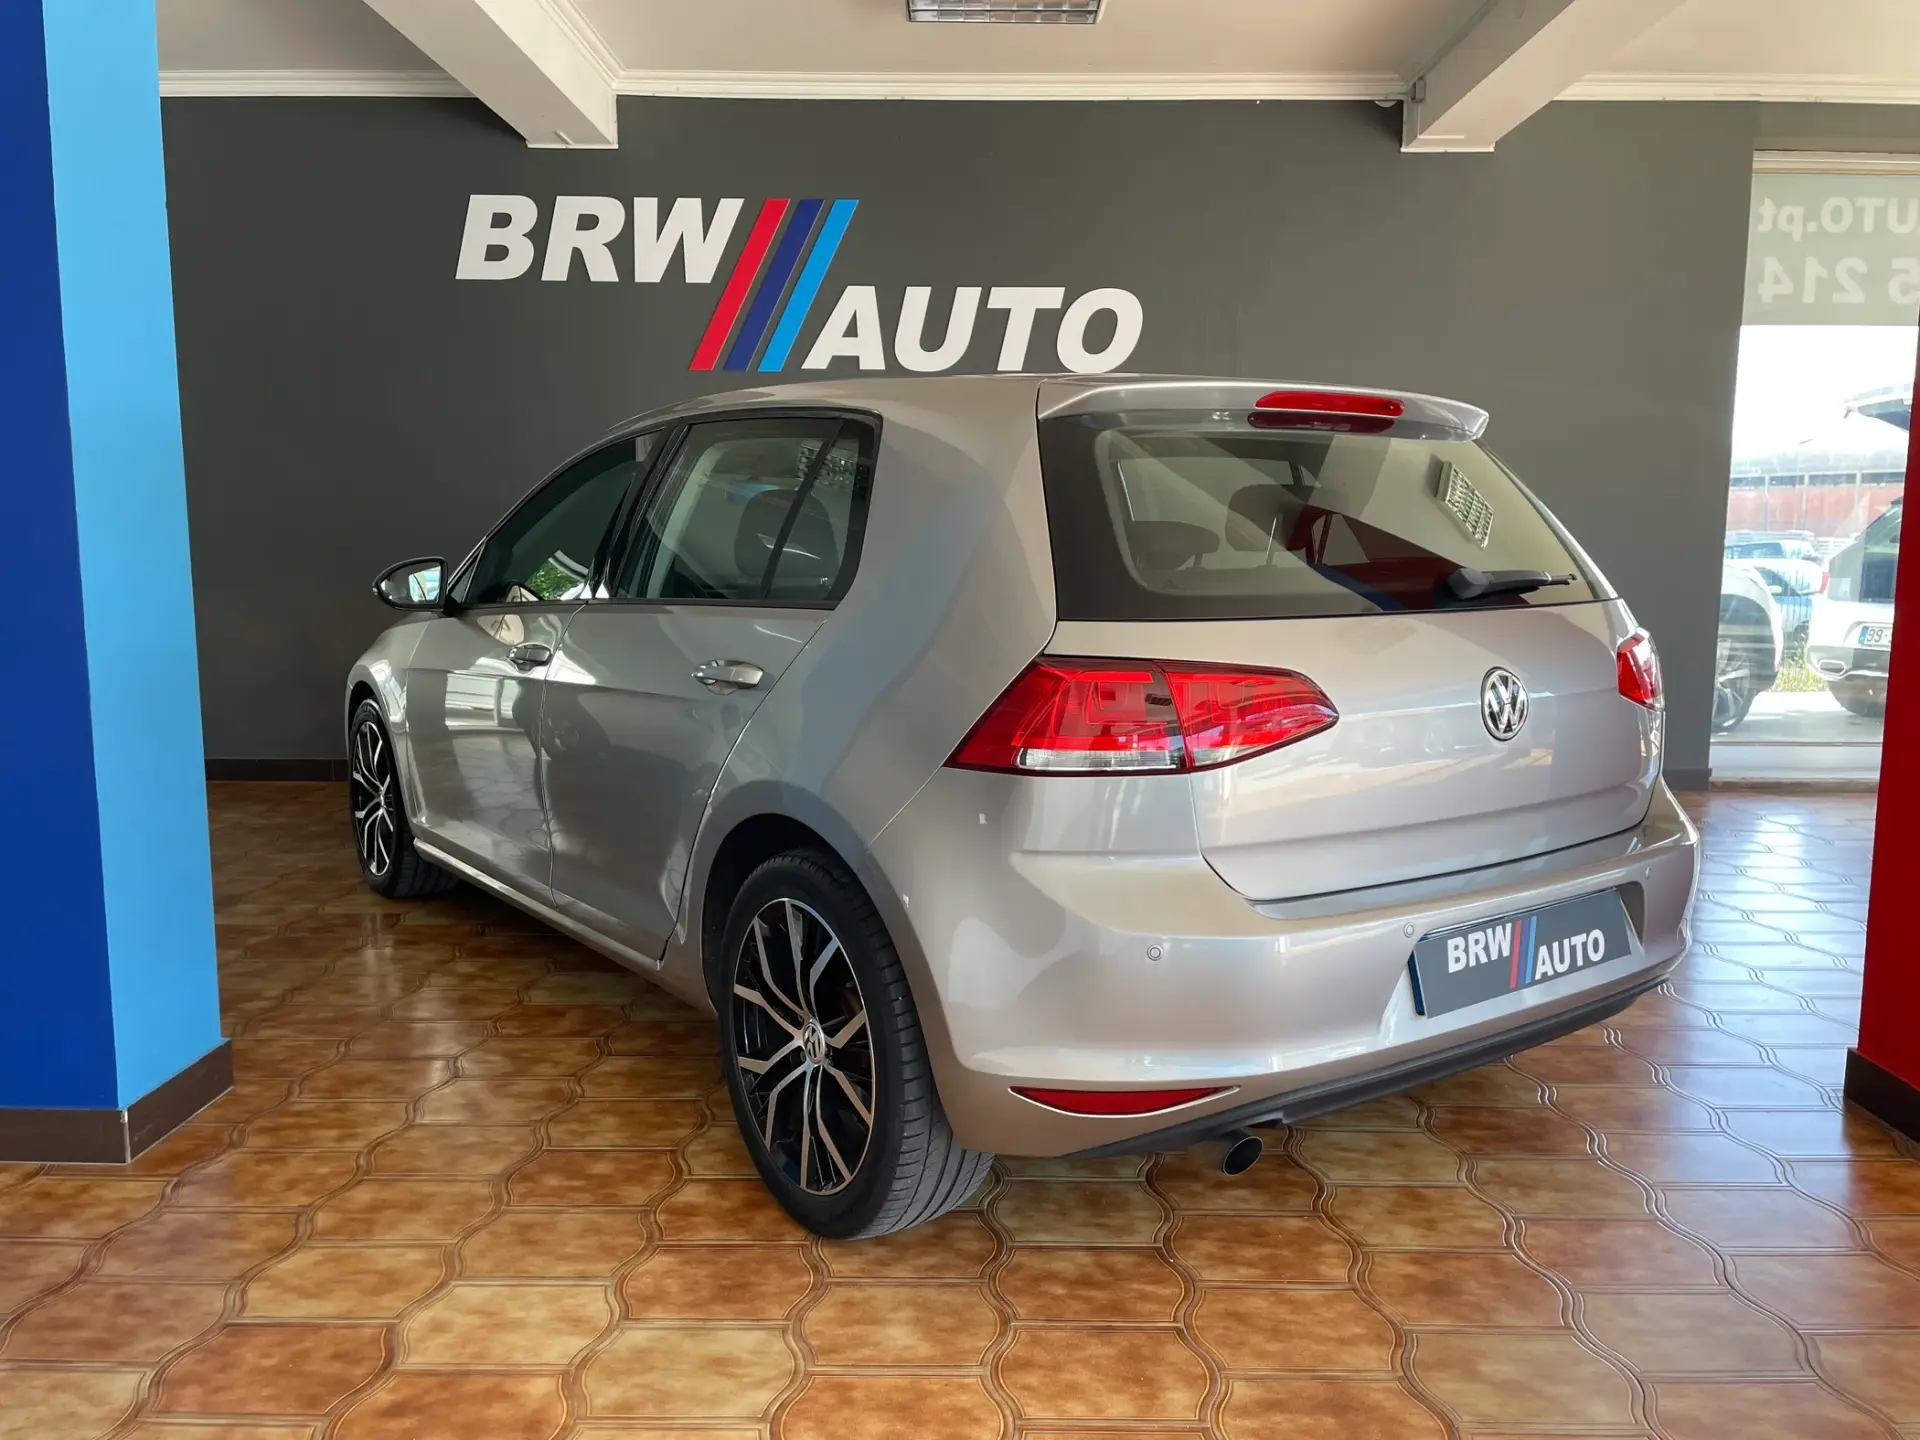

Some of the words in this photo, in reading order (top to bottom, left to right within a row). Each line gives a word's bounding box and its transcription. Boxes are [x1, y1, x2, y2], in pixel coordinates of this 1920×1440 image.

[455, 194, 745, 283] BRW
[801, 285, 1144, 373] AUTO
[1447, 922, 1513, 974] BRW
[1534, 928, 1606, 981] AUTO
